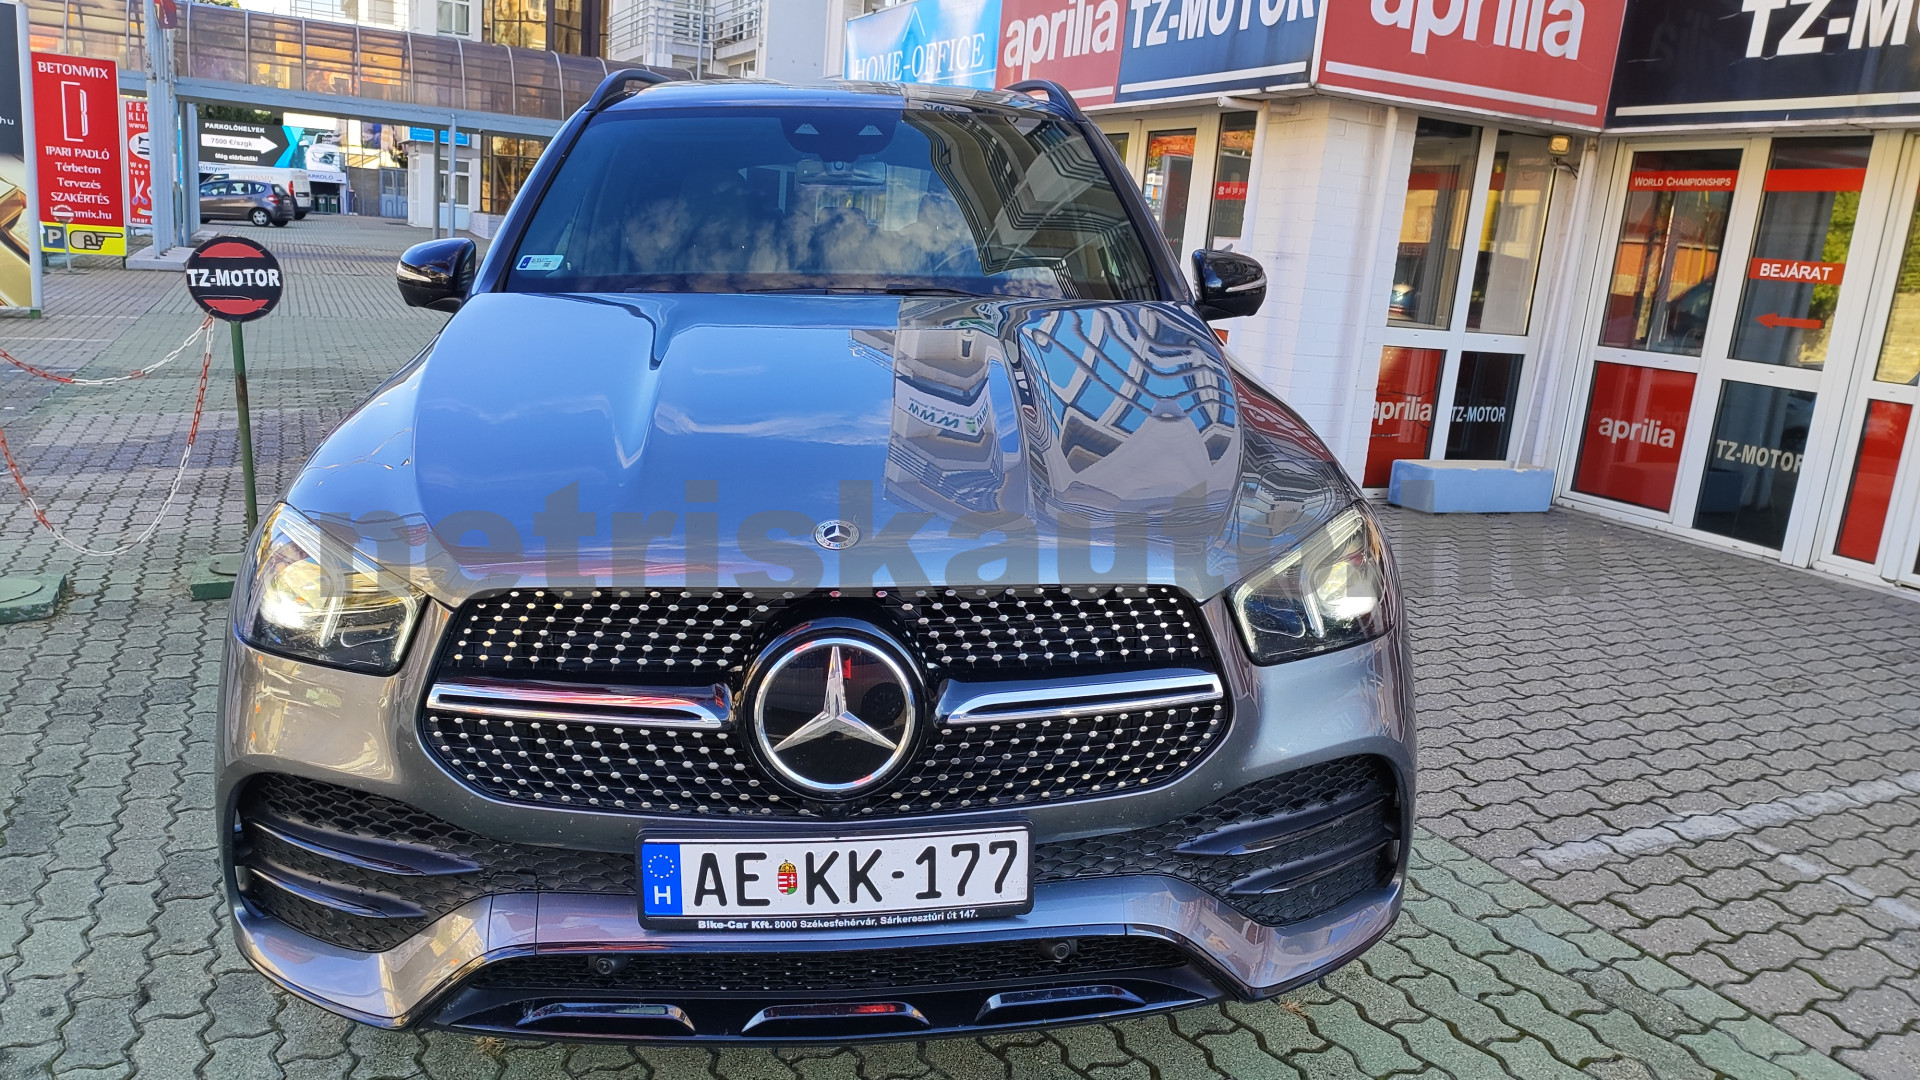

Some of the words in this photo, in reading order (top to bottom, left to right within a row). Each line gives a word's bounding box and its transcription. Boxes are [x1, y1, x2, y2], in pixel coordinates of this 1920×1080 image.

[1741, 0, 1920, 58] TZ-M
[1004, 0, 1118, 81] aprilia
[854, 33, 985, 82] HOME-OFFICE
[37, 61, 108, 79] BETONMIX
[127, 102, 148, 112] TEX
[128, 112, 149, 122] KLI
[205, 122, 265, 133] PARKOLÓHELYEK
[45, 146, 71, 157] IPARI
[75, 148, 109, 160] PADLÓ
[55, 162, 101, 174] Térbeton
[308, 173, 333, 181] ARKOLÓ
[57, 177, 101, 189] Tervezés
[50, 191, 110, 205] SZAKÉRTÉS
[187, 268, 280, 287] TZ-MOTOR
[1759, 262, 1833, 280] BEJÁRAT
[1451, 406, 1506, 422] TZ-MOTOR
[1598, 418, 1676, 449] aprilia
[694, 852, 771, 907] AE
[805, 840, 1018, 905] KK-177
[653, 885, 672, 905] H
[698, 920, 748, 929] Bike-Car
[751, 920, 773, 929] Kft.
[774, 921, 797, 929] 8000
[800, 918, 878, 928] Székesfehérvár,
[959, 910, 979, 919] 147.
